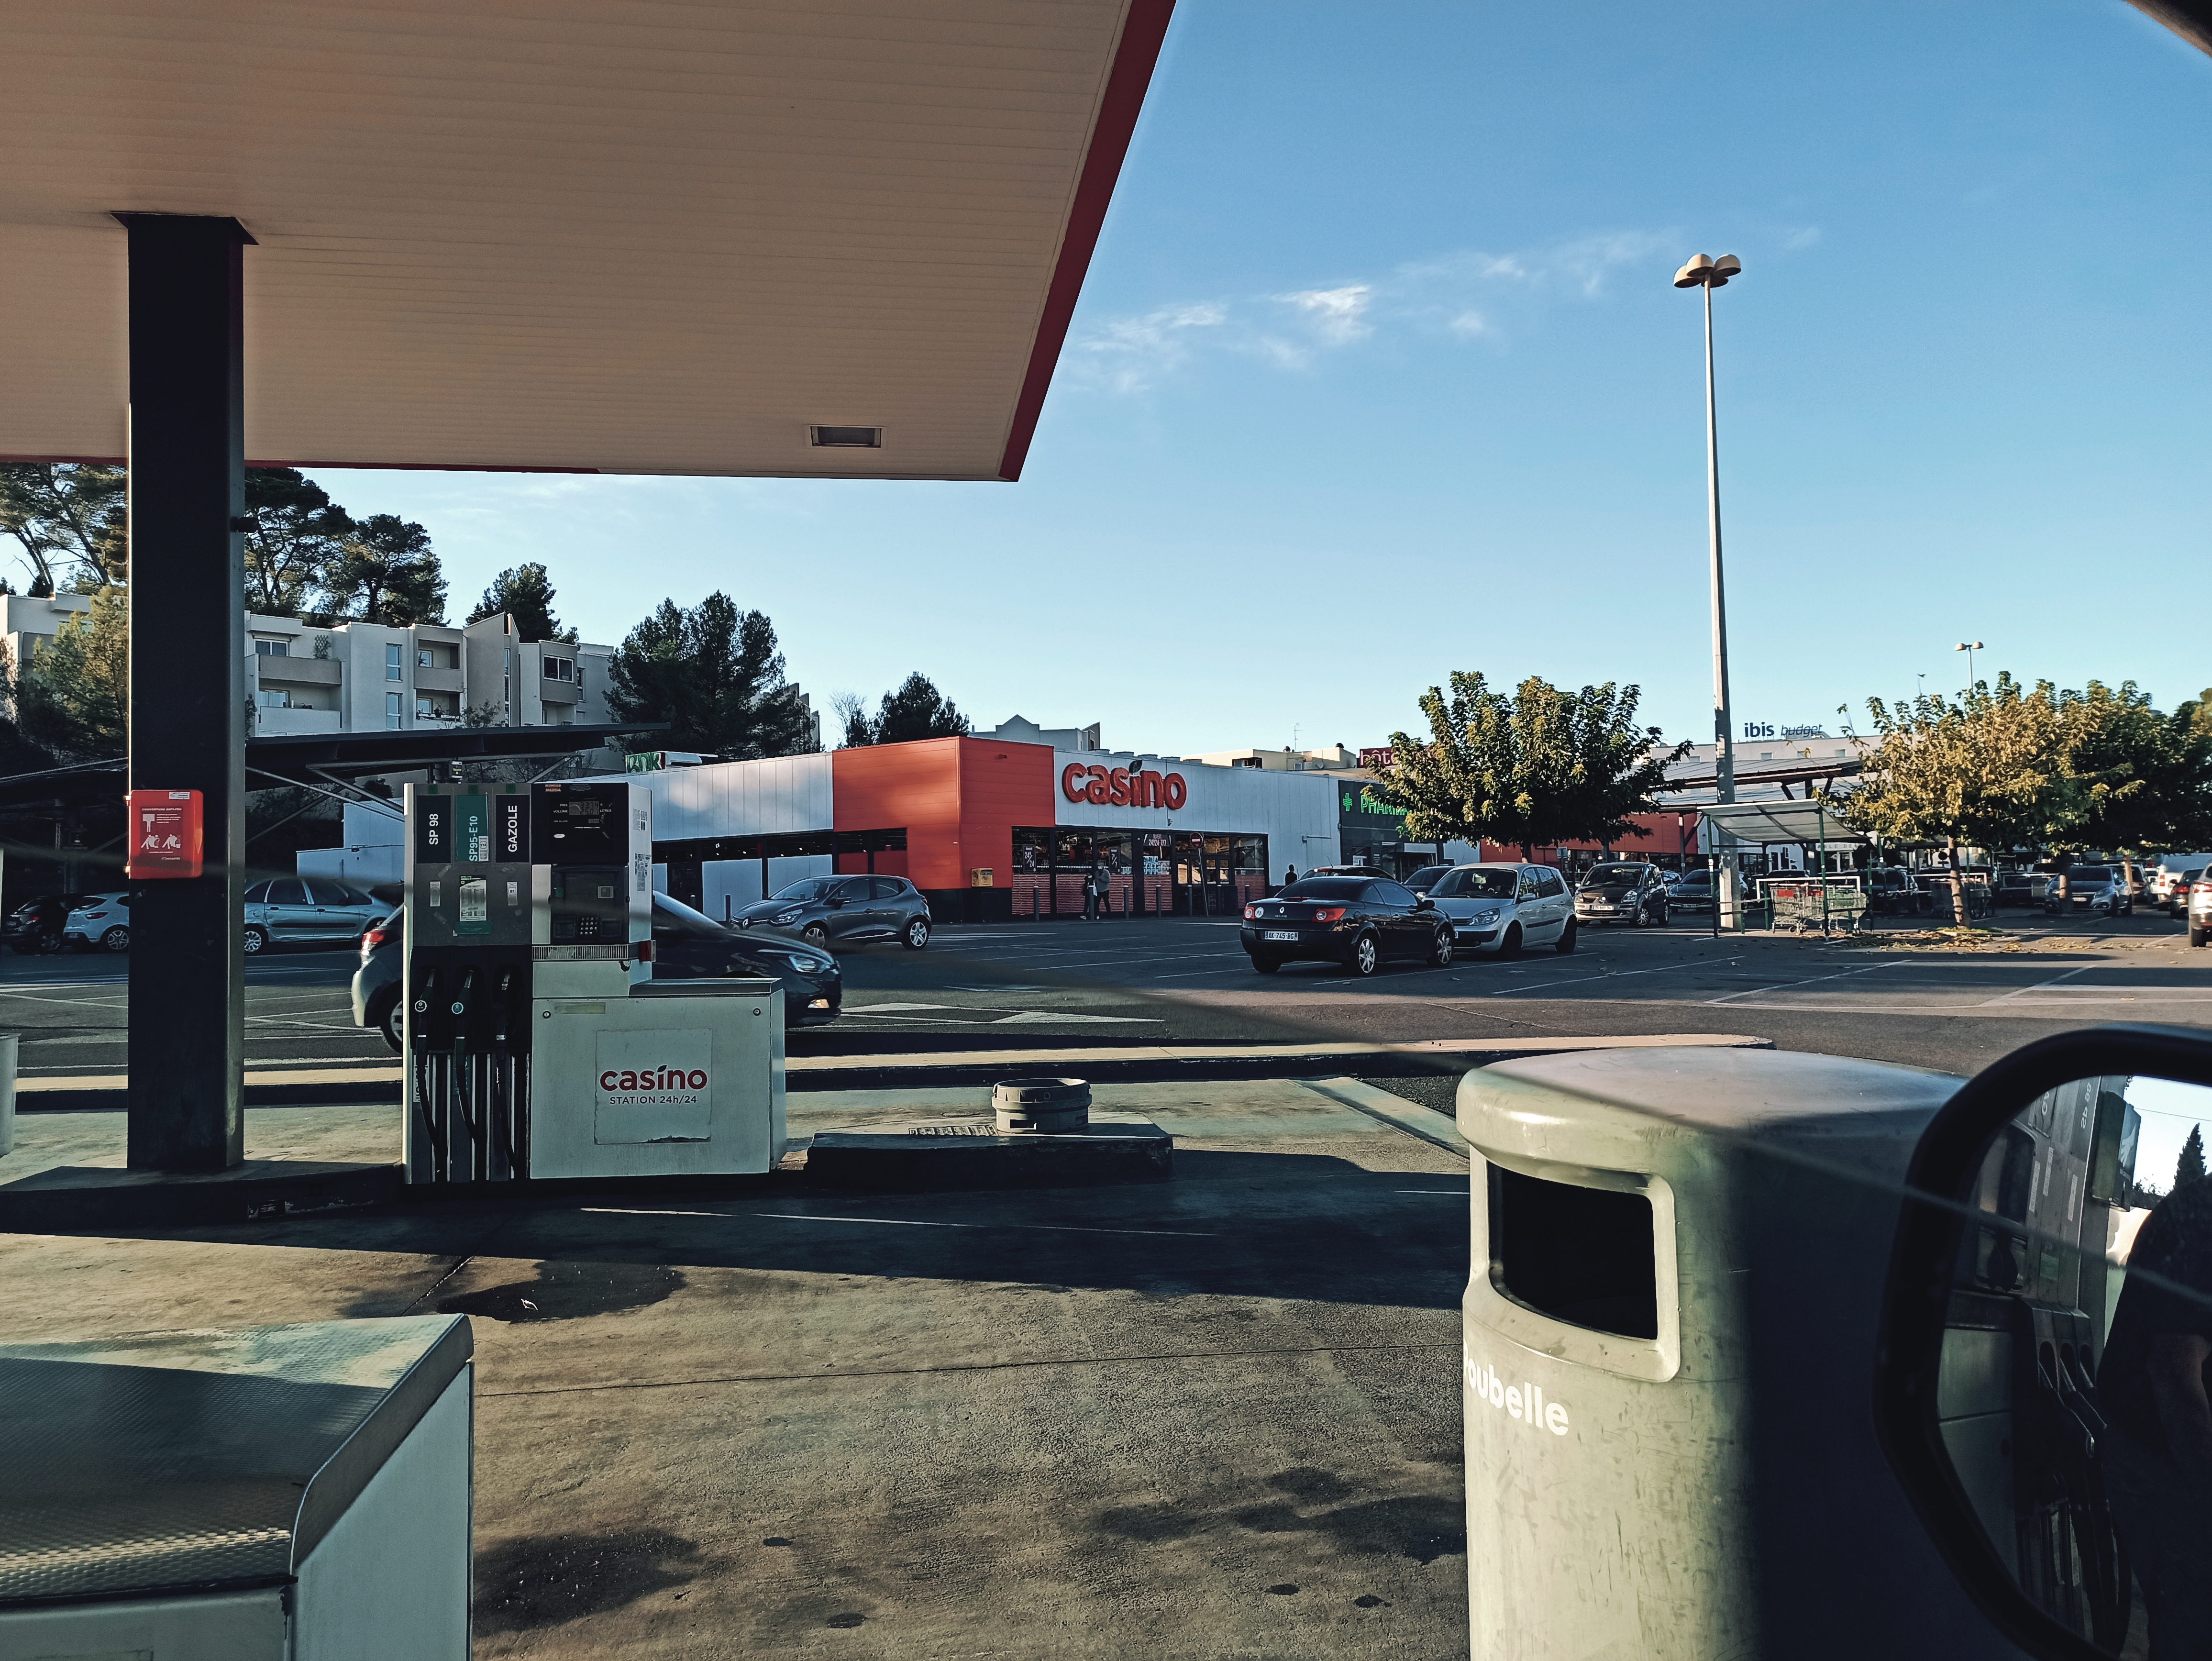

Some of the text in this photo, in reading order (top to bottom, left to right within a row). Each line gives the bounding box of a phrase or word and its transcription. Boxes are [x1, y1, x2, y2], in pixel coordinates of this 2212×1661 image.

[1744, 721, 1823, 738] ibis budget
[1062, 760, 1187, 810] casino
[429, 813, 439, 845] SP 98
[469, 816, 478, 862] SP95-E10
[508, 805, 518, 852] GAZOLE
[600, 1064, 708, 1091] casino
[610, 1095, 697, 1105] STATION 24h/24
